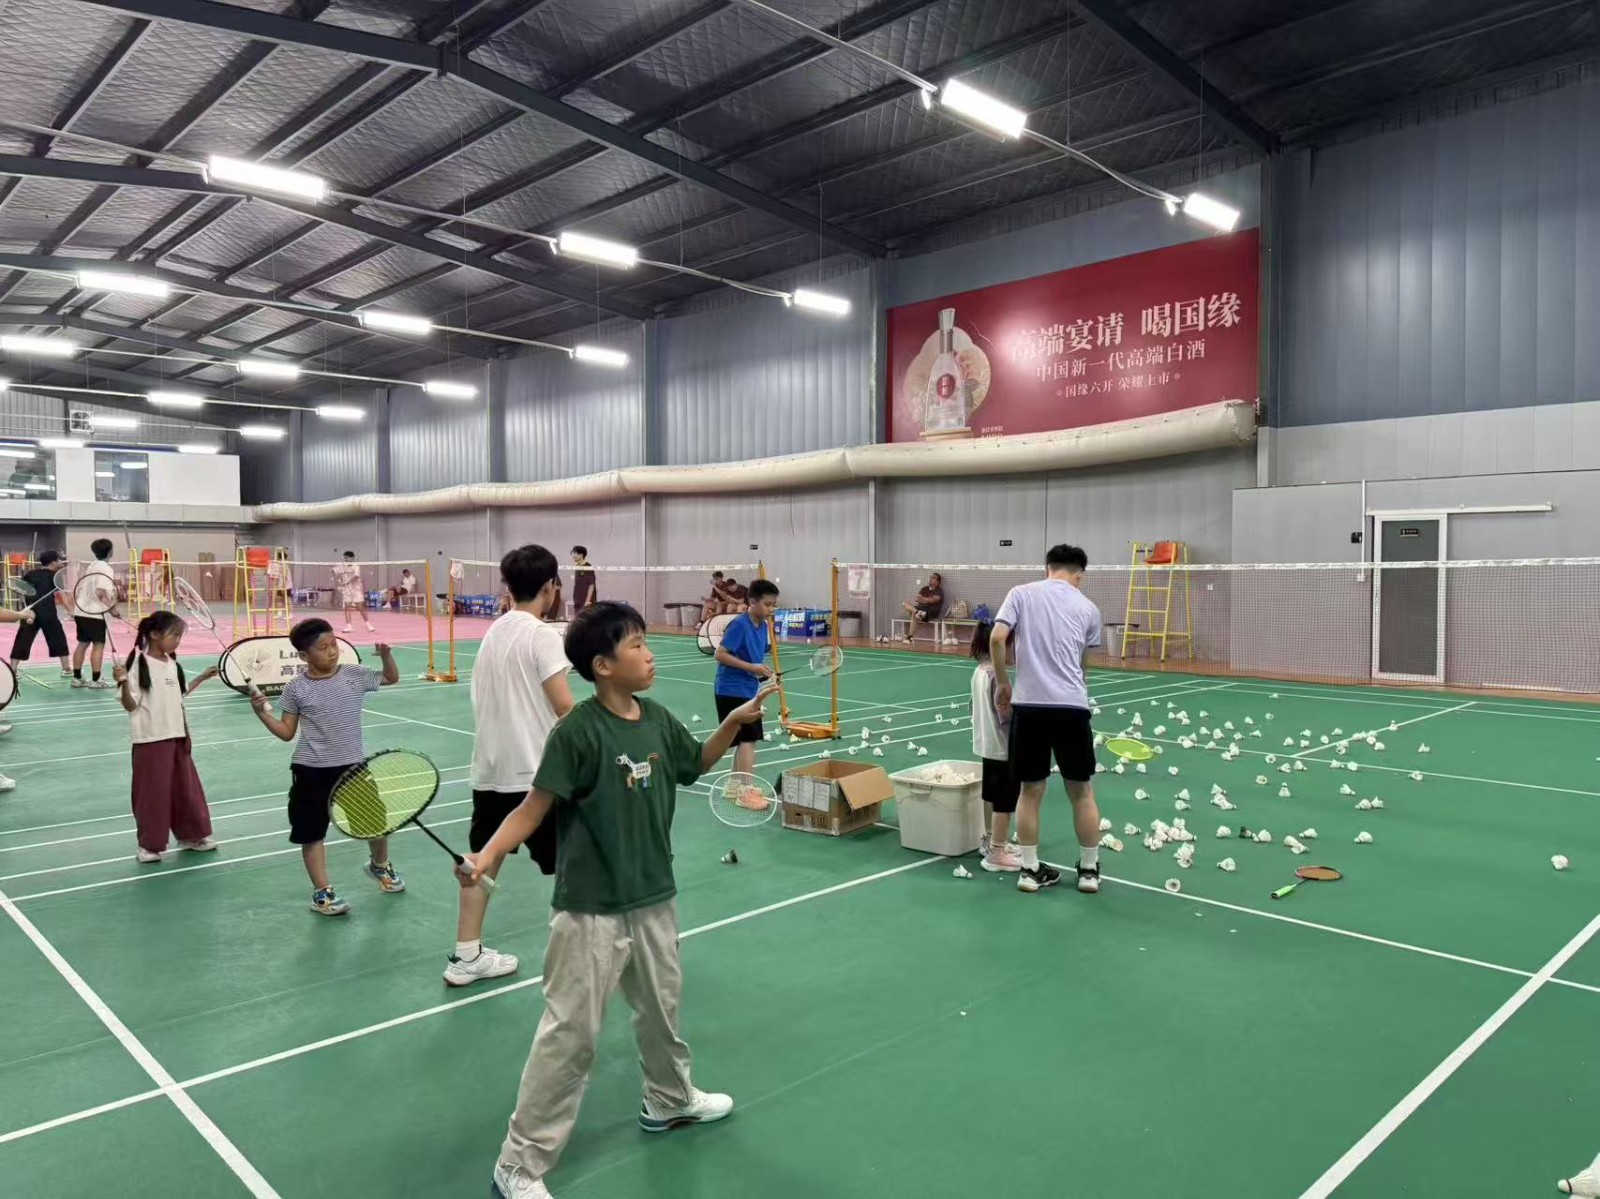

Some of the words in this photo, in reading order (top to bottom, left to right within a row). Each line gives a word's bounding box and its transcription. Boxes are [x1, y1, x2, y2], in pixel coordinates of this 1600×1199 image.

[1011, 312, 1124, 361] 高端宴请
[1141, 292, 1242, 338] 喝国缘
[1036, 338, 1206, 382] 中国新一代高端白酒
[1065, 379, 1114, 398] 国缘六开
[1118, 372, 1170, 390] 荣耀上市
[279, 649, 299, 660] Lu
